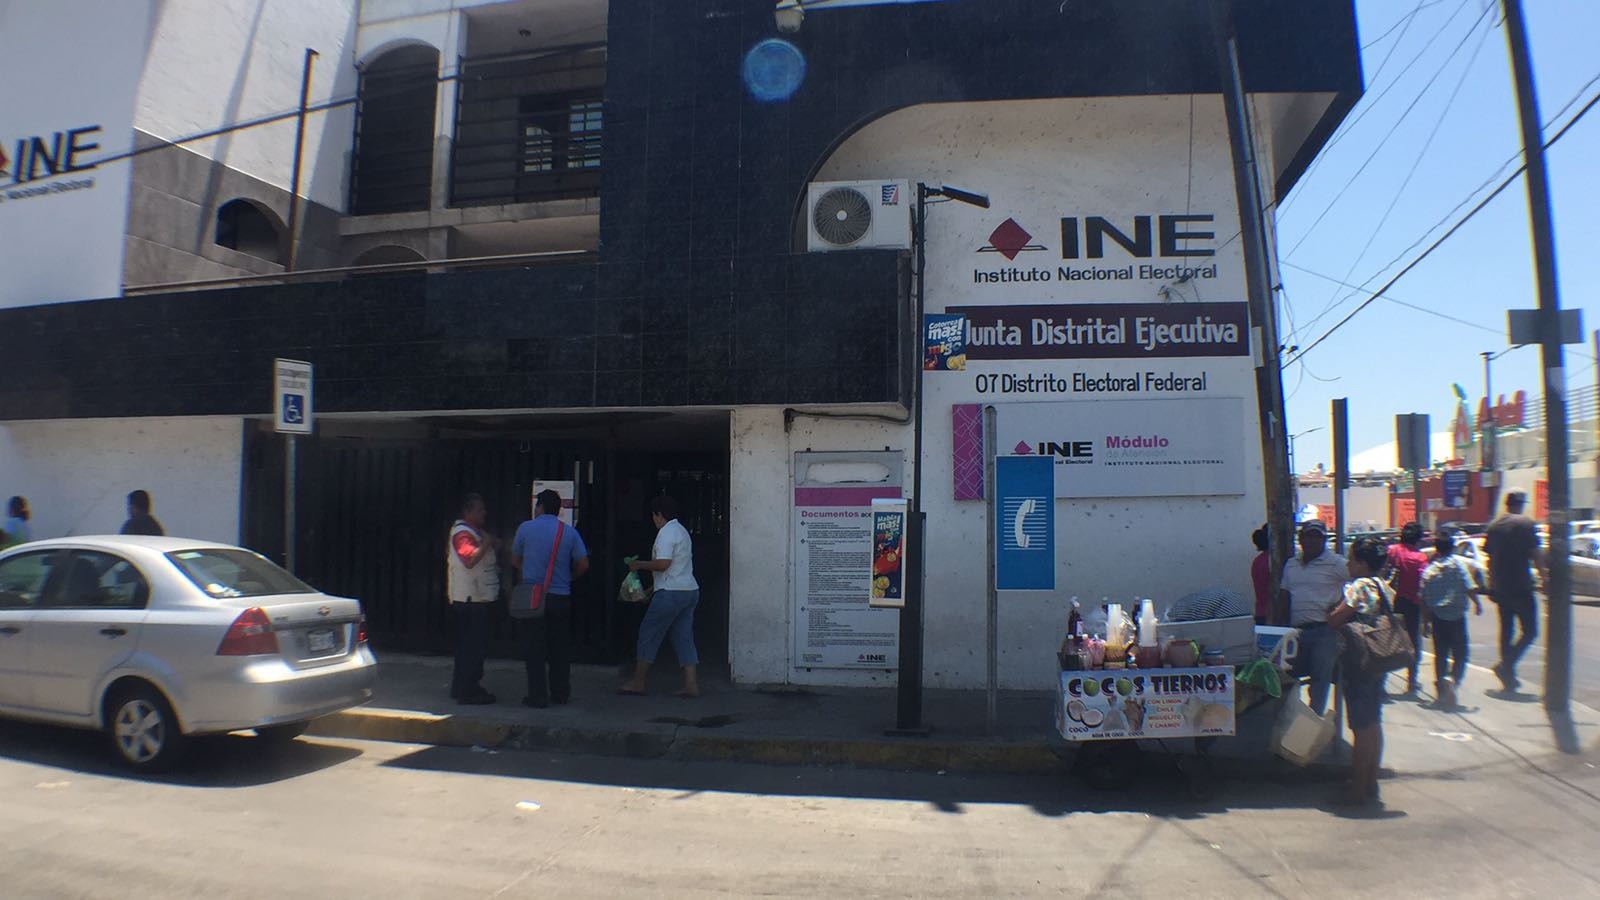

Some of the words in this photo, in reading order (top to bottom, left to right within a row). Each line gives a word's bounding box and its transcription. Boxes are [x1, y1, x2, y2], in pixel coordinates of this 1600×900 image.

[12, 125, 103, 184] INE
[1061, 214, 1216, 260] INE
[973, 267, 1051, 283] Instituto
[1058, 265, 1133, 281] Nacional
[1139, 263, 1217, 280] Electoral
[965, 319, 1022, 346] Junta
[1031, 317, 1126, 345] Distrital
[1135, 316, 1239, 351] Ejecutiva
[975, 374, 998, 393] 07
[1002, 373, 1067, 393] Distrito
[1073, 372, 1140, 393] Electoral
[1145, 371, 1207, 391] Federal
[1038, 441, 1093, 457] INE
[1106, 435, 1169, 449] Módulo
[801, 510, 859, 518] Documentos
[1068, 676, 1145, 697] COCOS
[1150, 673, 1227, 694] TIERNOS
